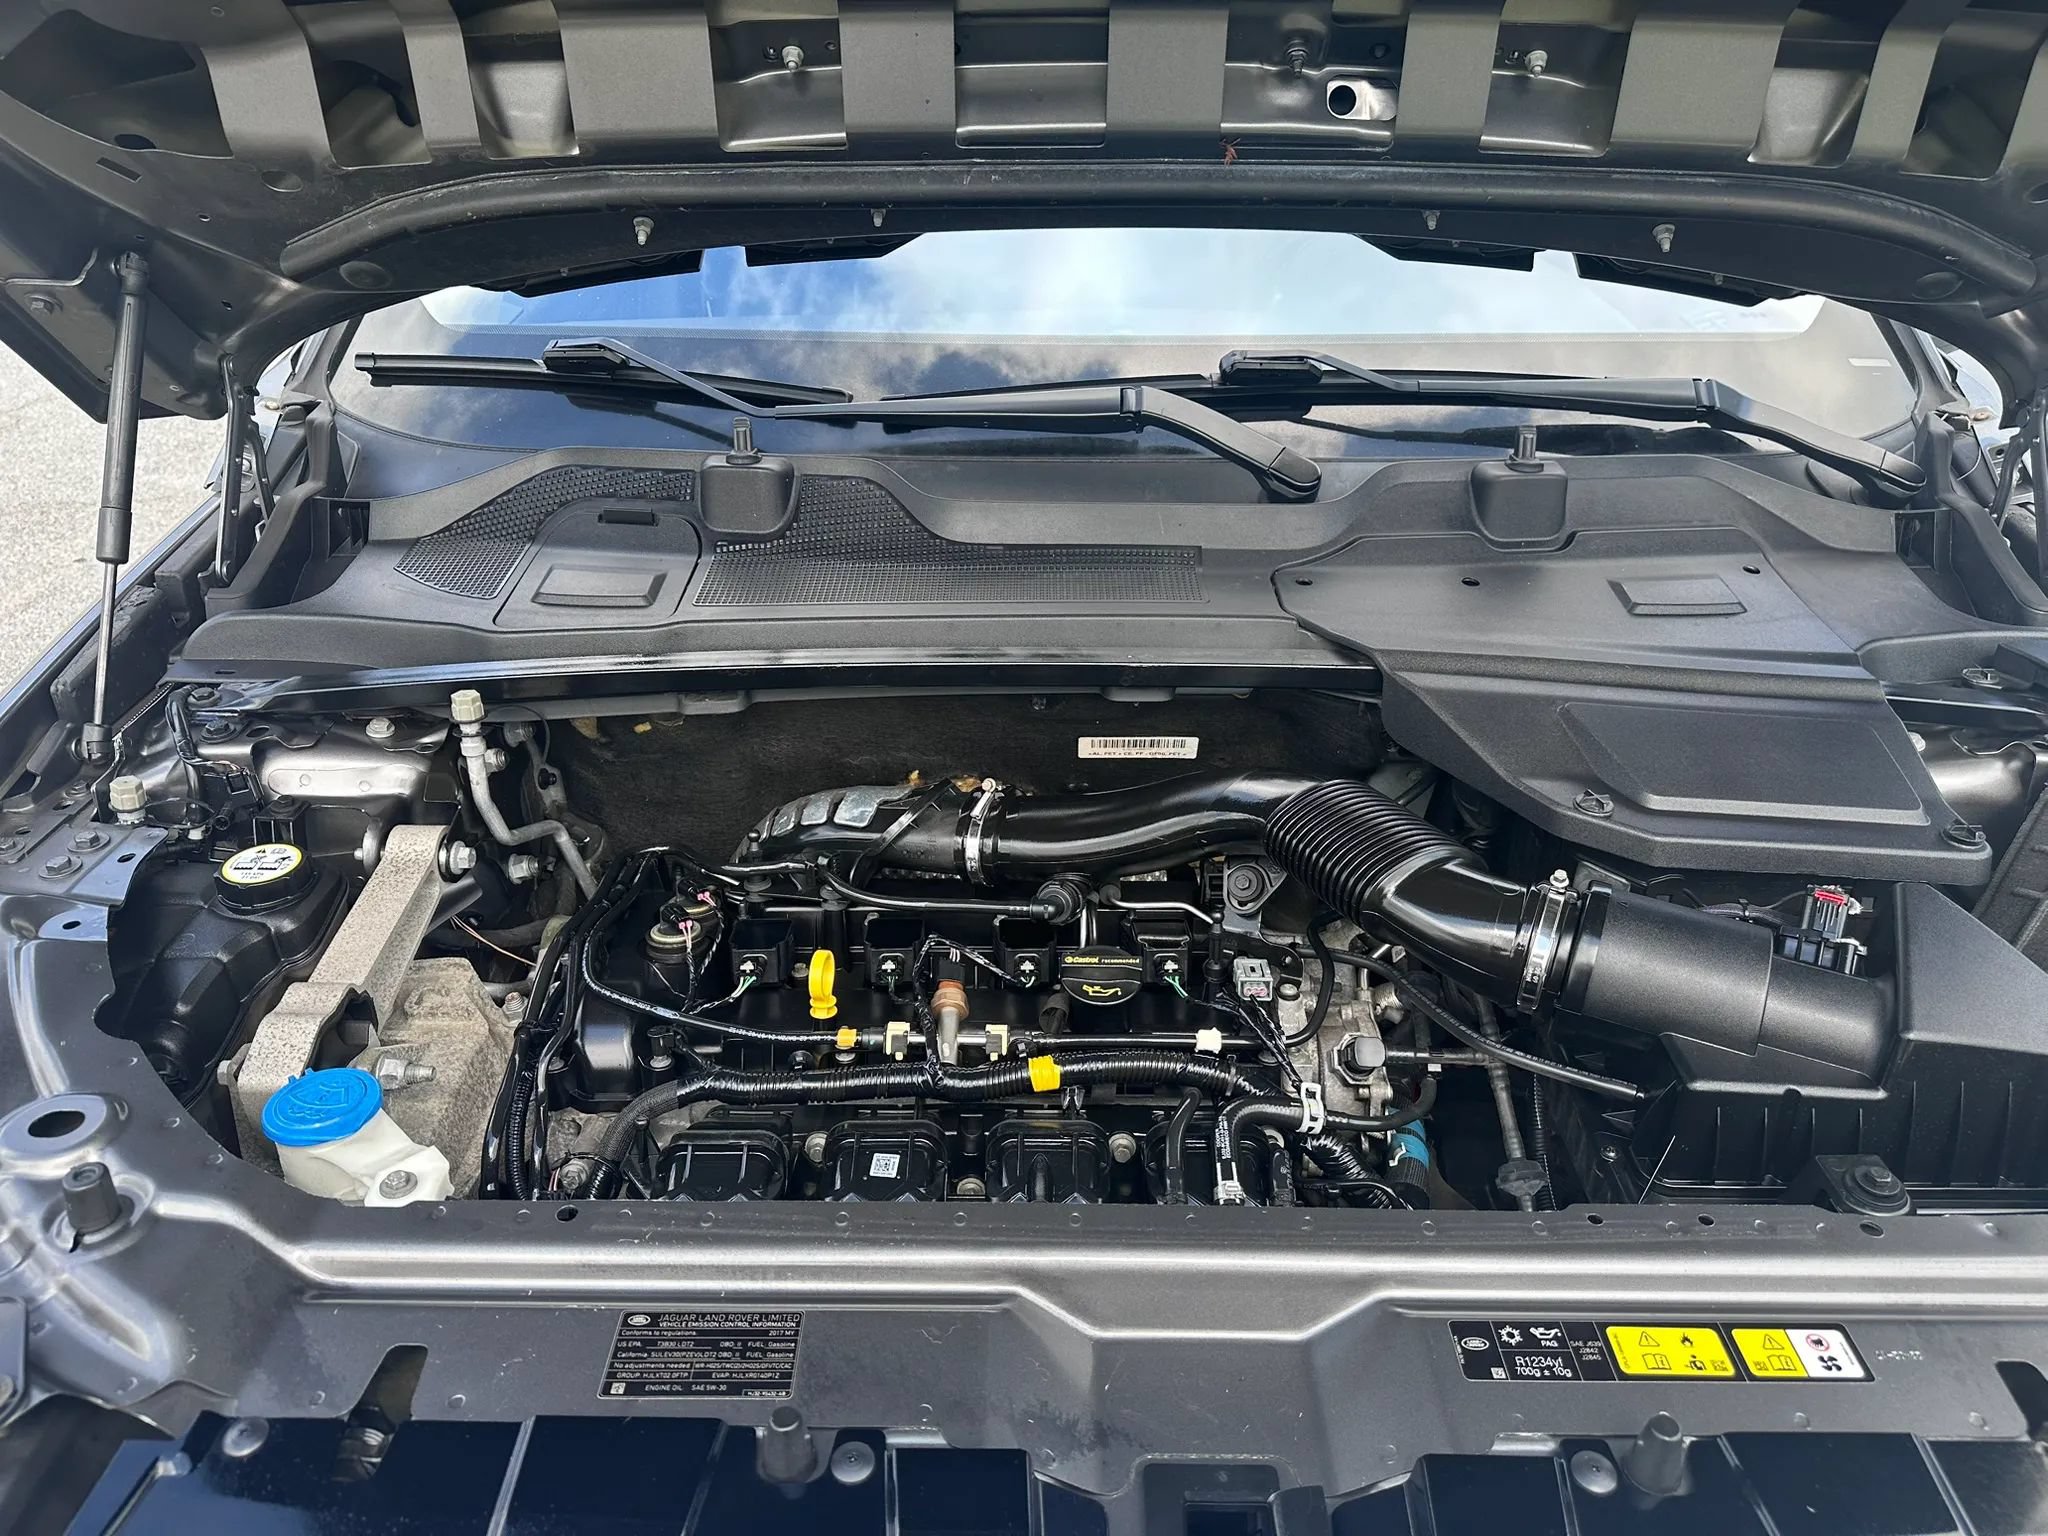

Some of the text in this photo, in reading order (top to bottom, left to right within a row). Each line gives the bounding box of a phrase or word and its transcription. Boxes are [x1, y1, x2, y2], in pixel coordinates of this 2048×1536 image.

[1073, 956, 1099, 964] Castrol
[698, 1314, 725, 1322] LAND
[727, 1314, 760, 1322] ROVER
[761, 1314, 800, 1322] LIMITED
[1515, 1356, 1564, 1367] R1234yf
[1515, 1367, 1541, 1377] 700g
[1552, 1367, 1573, 1377] 10g
